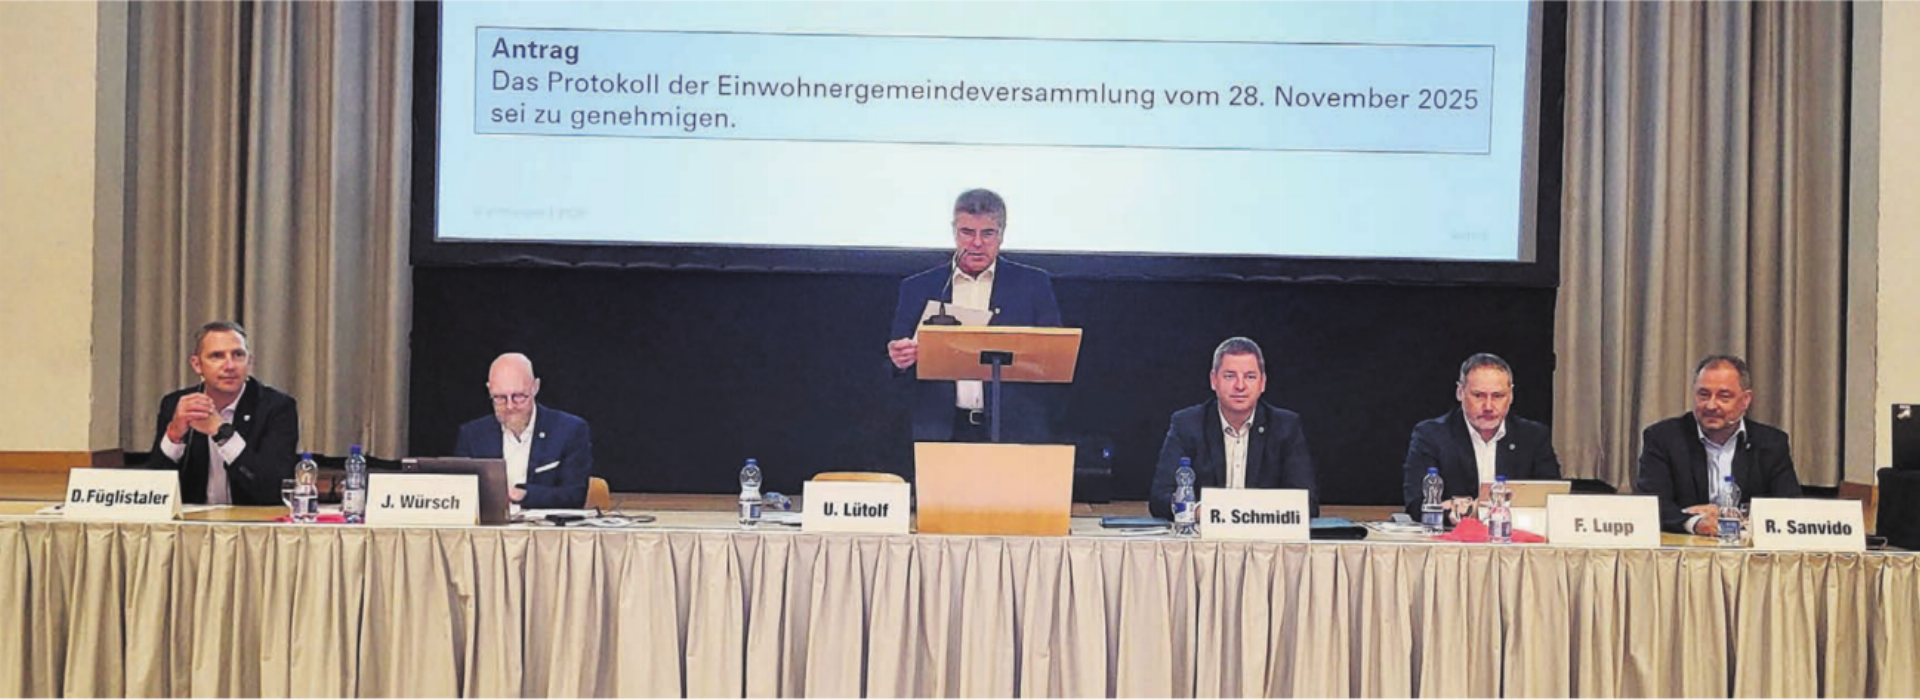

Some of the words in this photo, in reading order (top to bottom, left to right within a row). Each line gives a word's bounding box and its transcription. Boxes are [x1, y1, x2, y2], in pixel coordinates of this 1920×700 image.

[491, 37, 580, 65] Antrag
[492, 69, 539, 92] Das
[548, 71, 659, 95] Protokoll
[668, 73, 710, 96] der
[718, 74, 1155, 110] Einwohnergemeindeversammlung
[1164, 89, 1220, 106] vom
[1228, 85, 1265, 107] 28.
[1274, 85, 1410, 109] November
[1418, 88, 1479, 110] 2025
[490, 102, 526, 124] sei
[534, 108, 562, 124] zu
[571, 106, 737, 132] genehmigen.
[380, 494, 395, 509] J.
[400, 494, 460, 510] Würsch
[823, 501, 838, 517] U.
[843, 502, 889, 518] Lütolf
[1209, 508, 1226, 524] R.
[1230, 508, 1301, 525] Schmidli
[1574, 517, 1589, 533] F.
[1594, 518, 1635, 536] Lupp
[1764, 518, 1782, 534] R.
[1786, 519, 1853, 536] Sanvido
